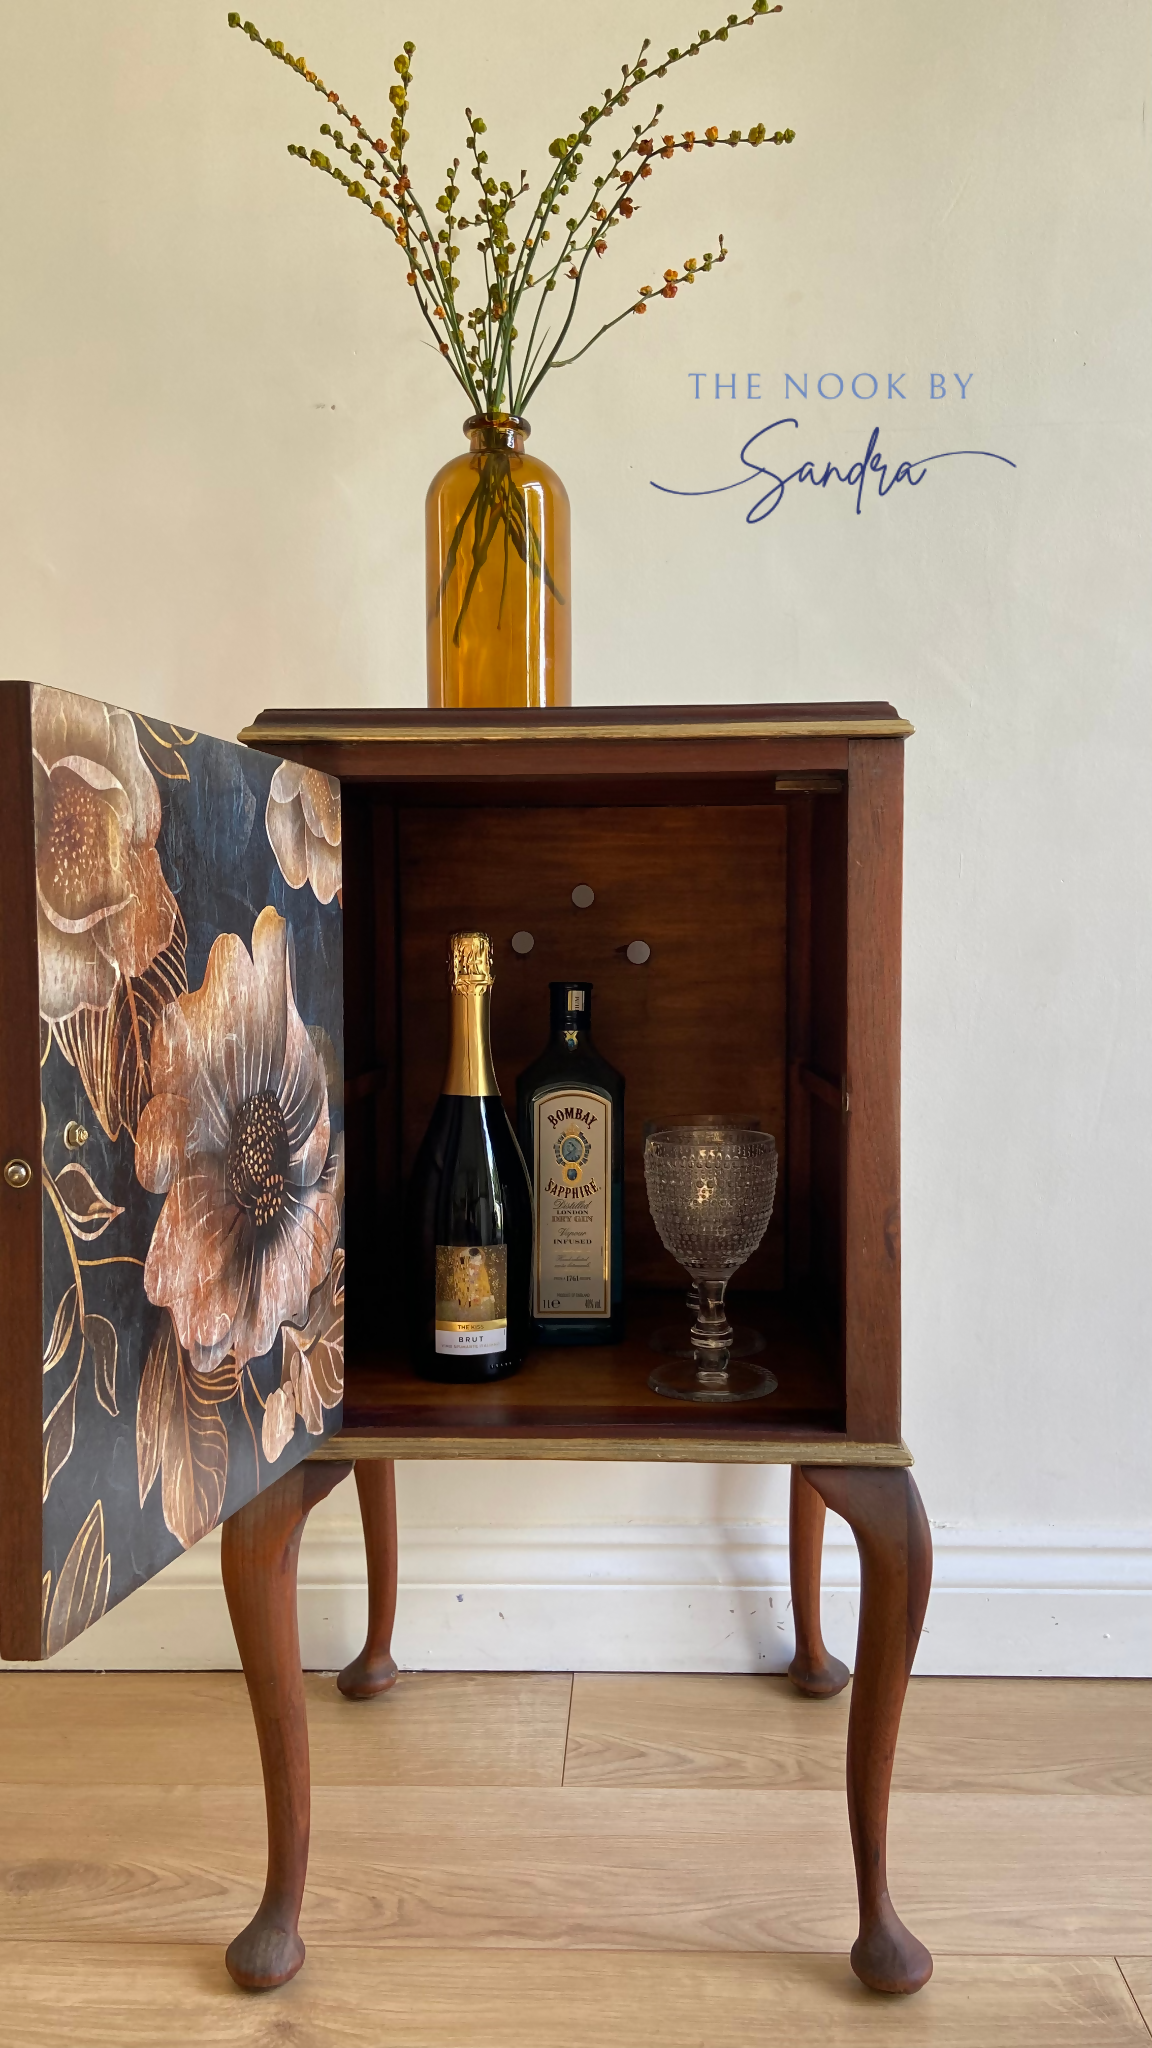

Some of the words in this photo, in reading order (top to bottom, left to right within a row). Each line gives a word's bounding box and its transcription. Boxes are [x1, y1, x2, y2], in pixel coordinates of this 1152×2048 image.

[547, 1107, 598, 1129] BOMBAY
[544, 1177, 598, 1199] SAPPHIRE
[553, 1199, 592, 1210] Distilled
